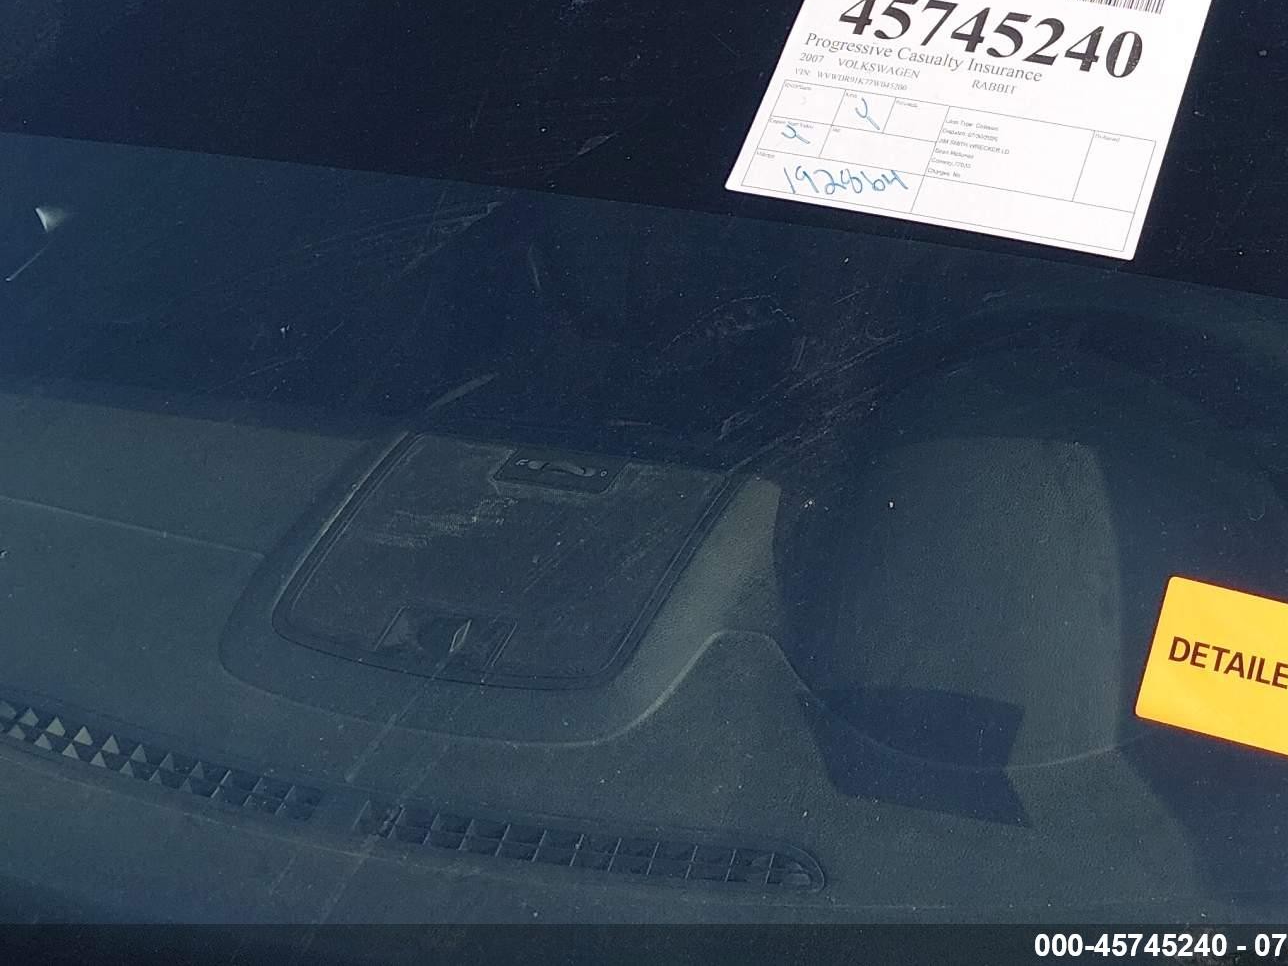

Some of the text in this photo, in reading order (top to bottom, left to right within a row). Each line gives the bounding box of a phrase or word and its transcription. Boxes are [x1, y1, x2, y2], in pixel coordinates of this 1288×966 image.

[799, 52, 1017, 95] 2007 VOLKSWAGEN RABBIT
[804, 32, 1043, 82] Progressive Casualty Insurance
